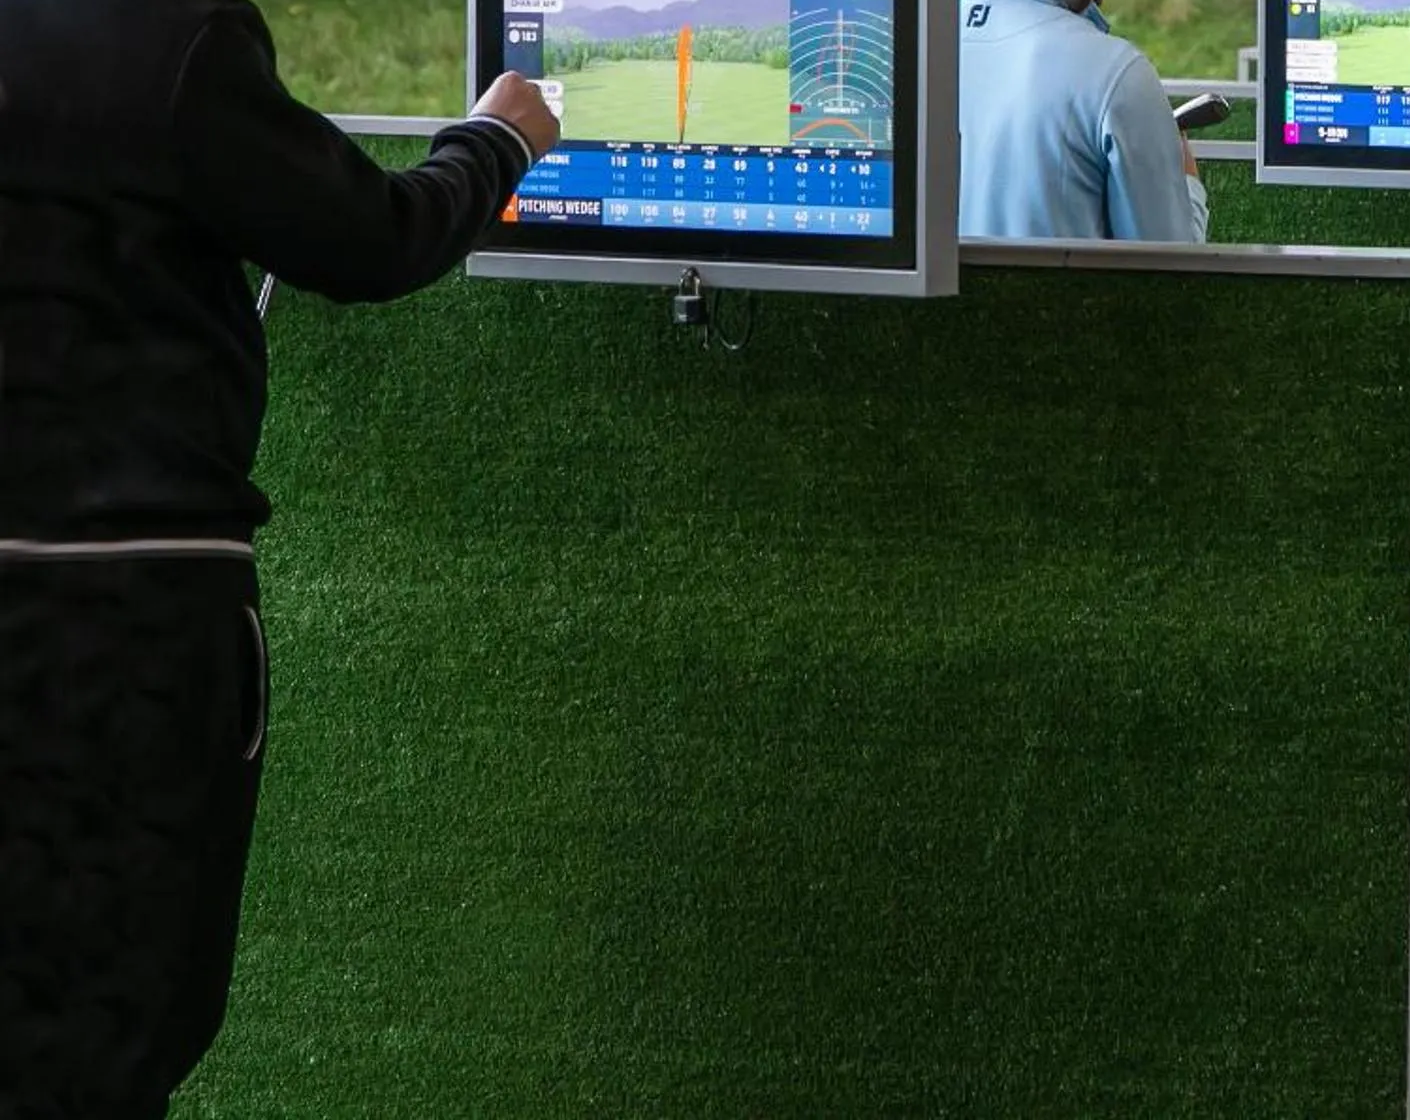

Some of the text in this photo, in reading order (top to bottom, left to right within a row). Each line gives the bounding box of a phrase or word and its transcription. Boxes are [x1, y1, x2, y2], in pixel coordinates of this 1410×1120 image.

[966, 4, 991, 27] FJ
[518, 199, 563, 214] PITCHING
[565, 200, 600, 215] WEDGE
